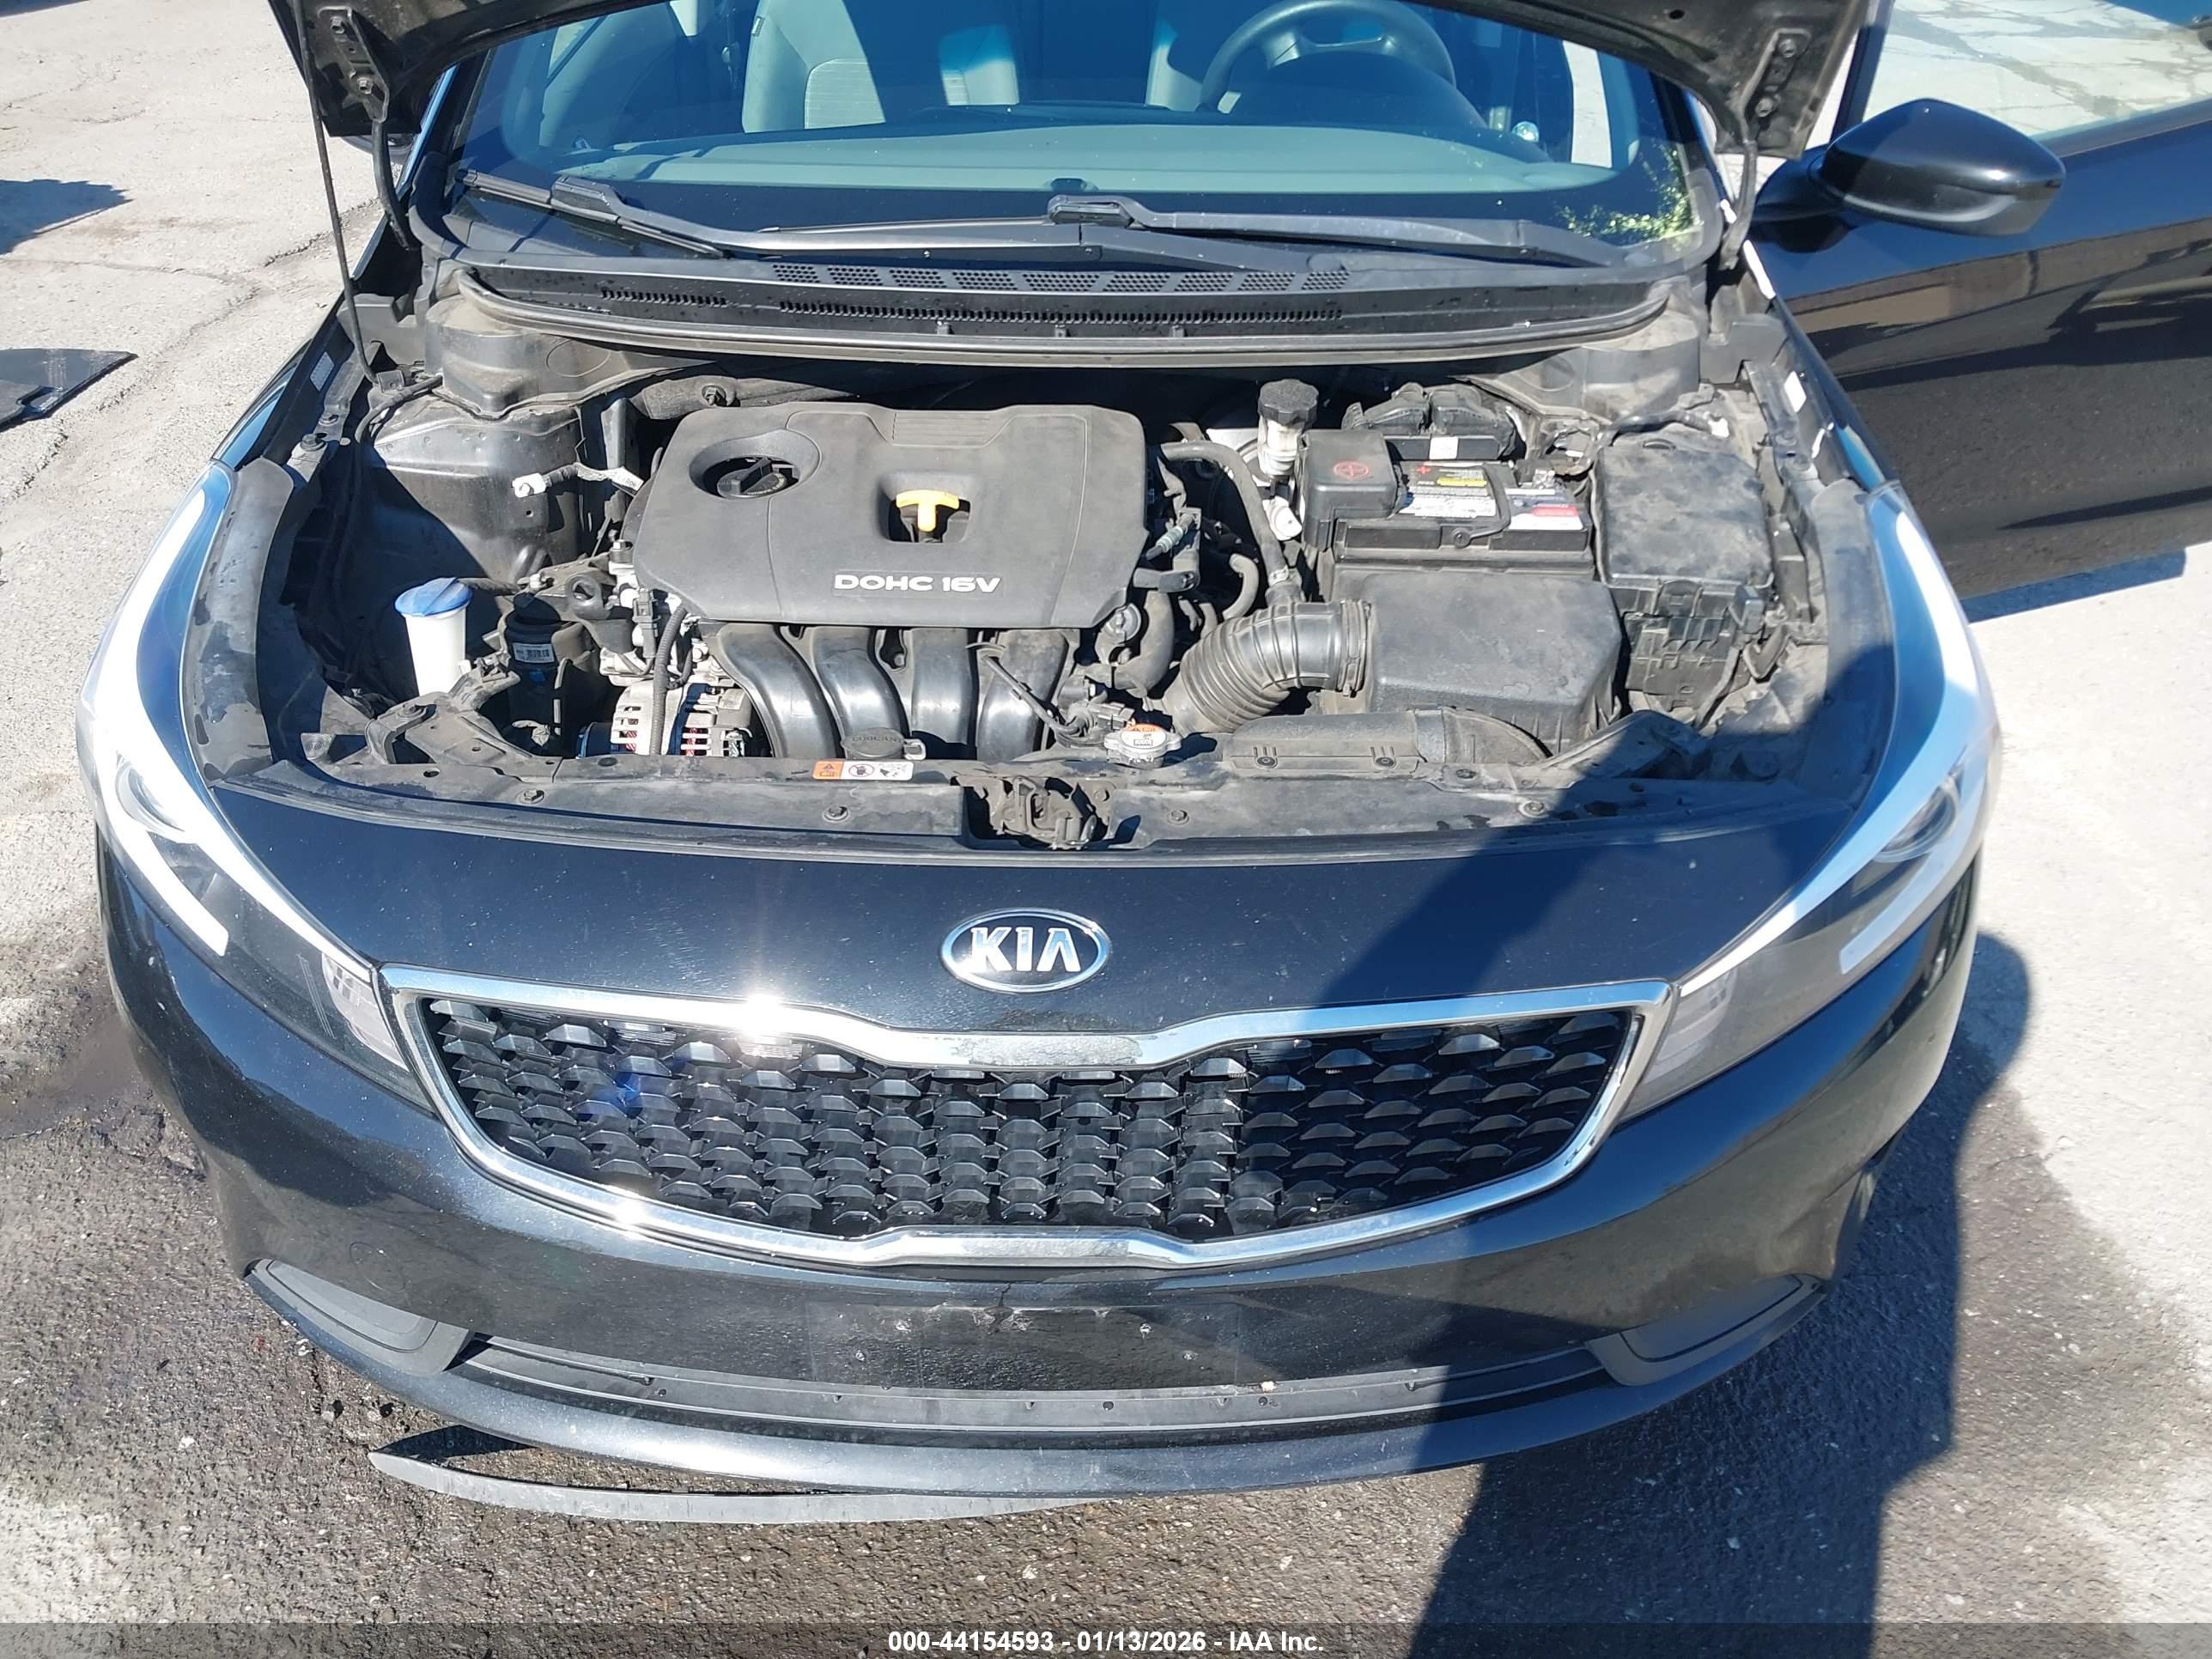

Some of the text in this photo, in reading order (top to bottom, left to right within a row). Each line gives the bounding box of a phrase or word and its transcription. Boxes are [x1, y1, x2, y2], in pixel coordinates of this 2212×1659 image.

[834, 574, 1001, 592] DOHC 16V
[970, 927, 1081, 972] KIA
